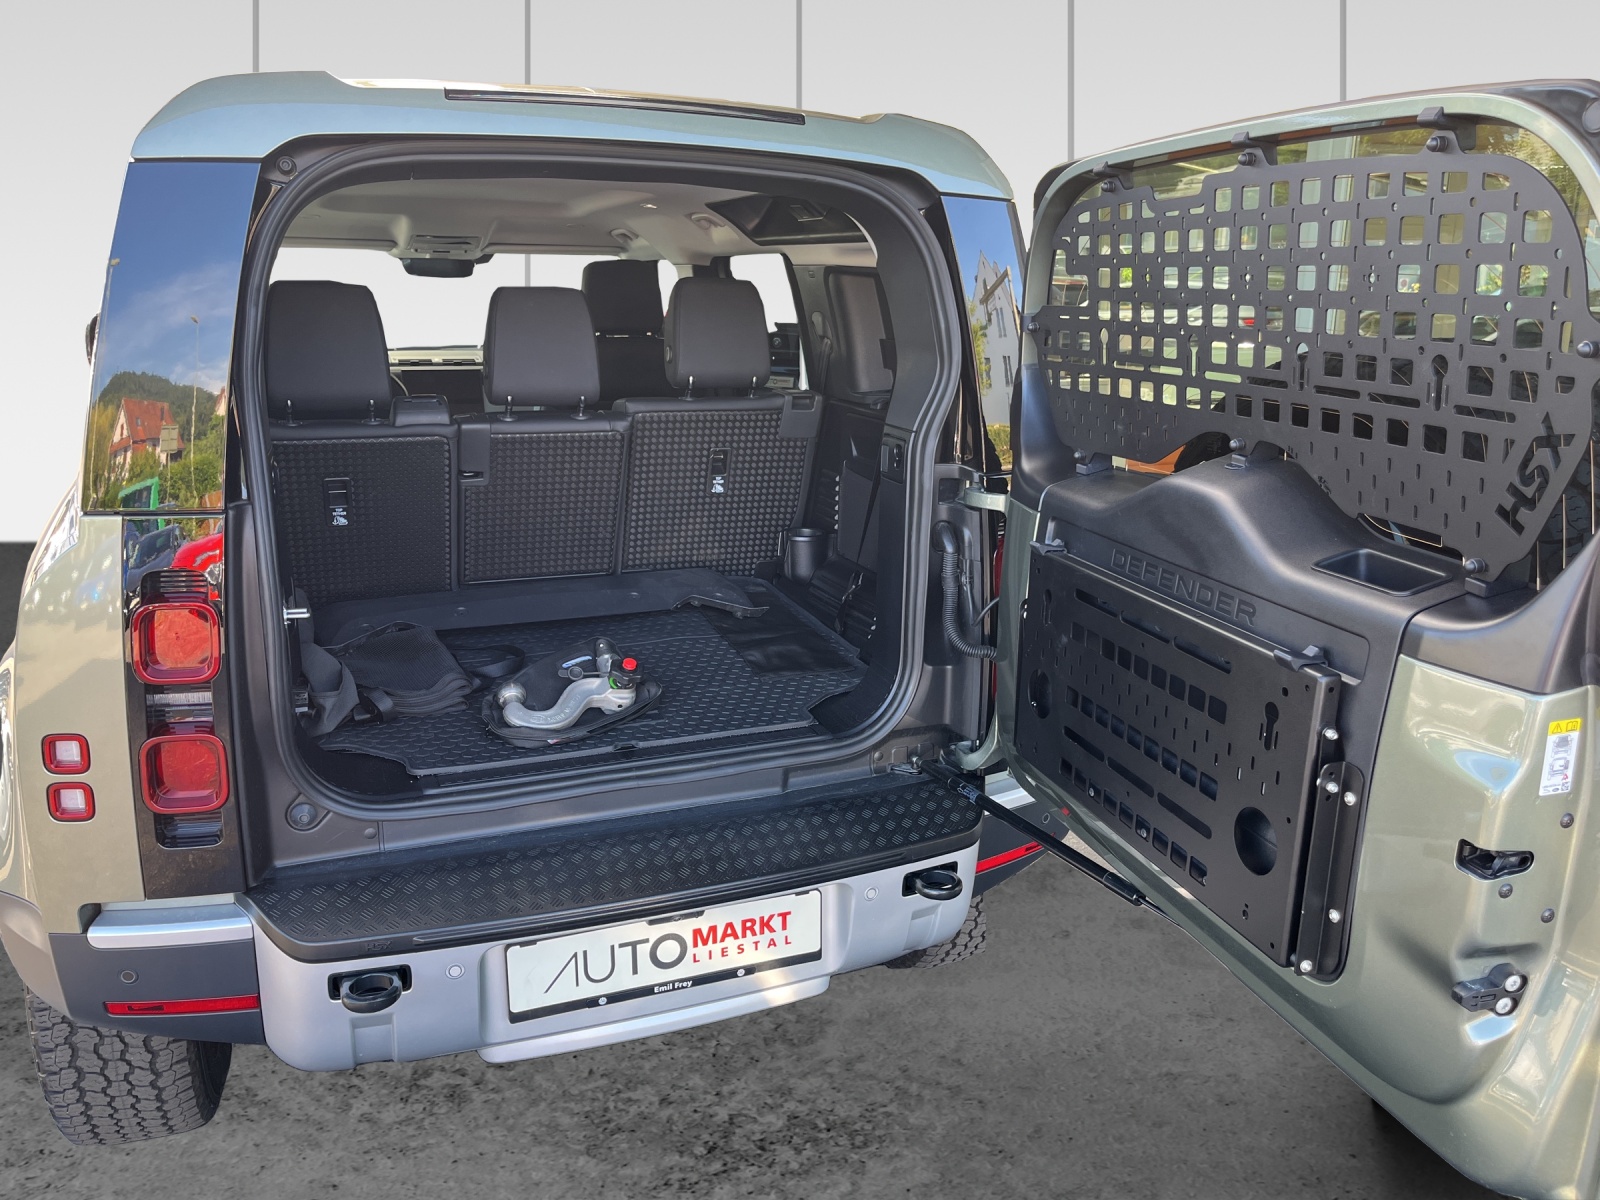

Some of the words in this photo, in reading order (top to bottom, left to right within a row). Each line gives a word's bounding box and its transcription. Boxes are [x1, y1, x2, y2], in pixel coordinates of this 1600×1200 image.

[1495, 411, 1576, 537] HSX
[1111, 548, 1257, 627] DEFENDER
[544, 932, 688, 994] AUTO
[692, 911, 792, 948] MARKT
[654, 983, 673, 993] Emil
[674, 980, 693, 989] Frey
[692, 935, 792, 964] LIESTAL
